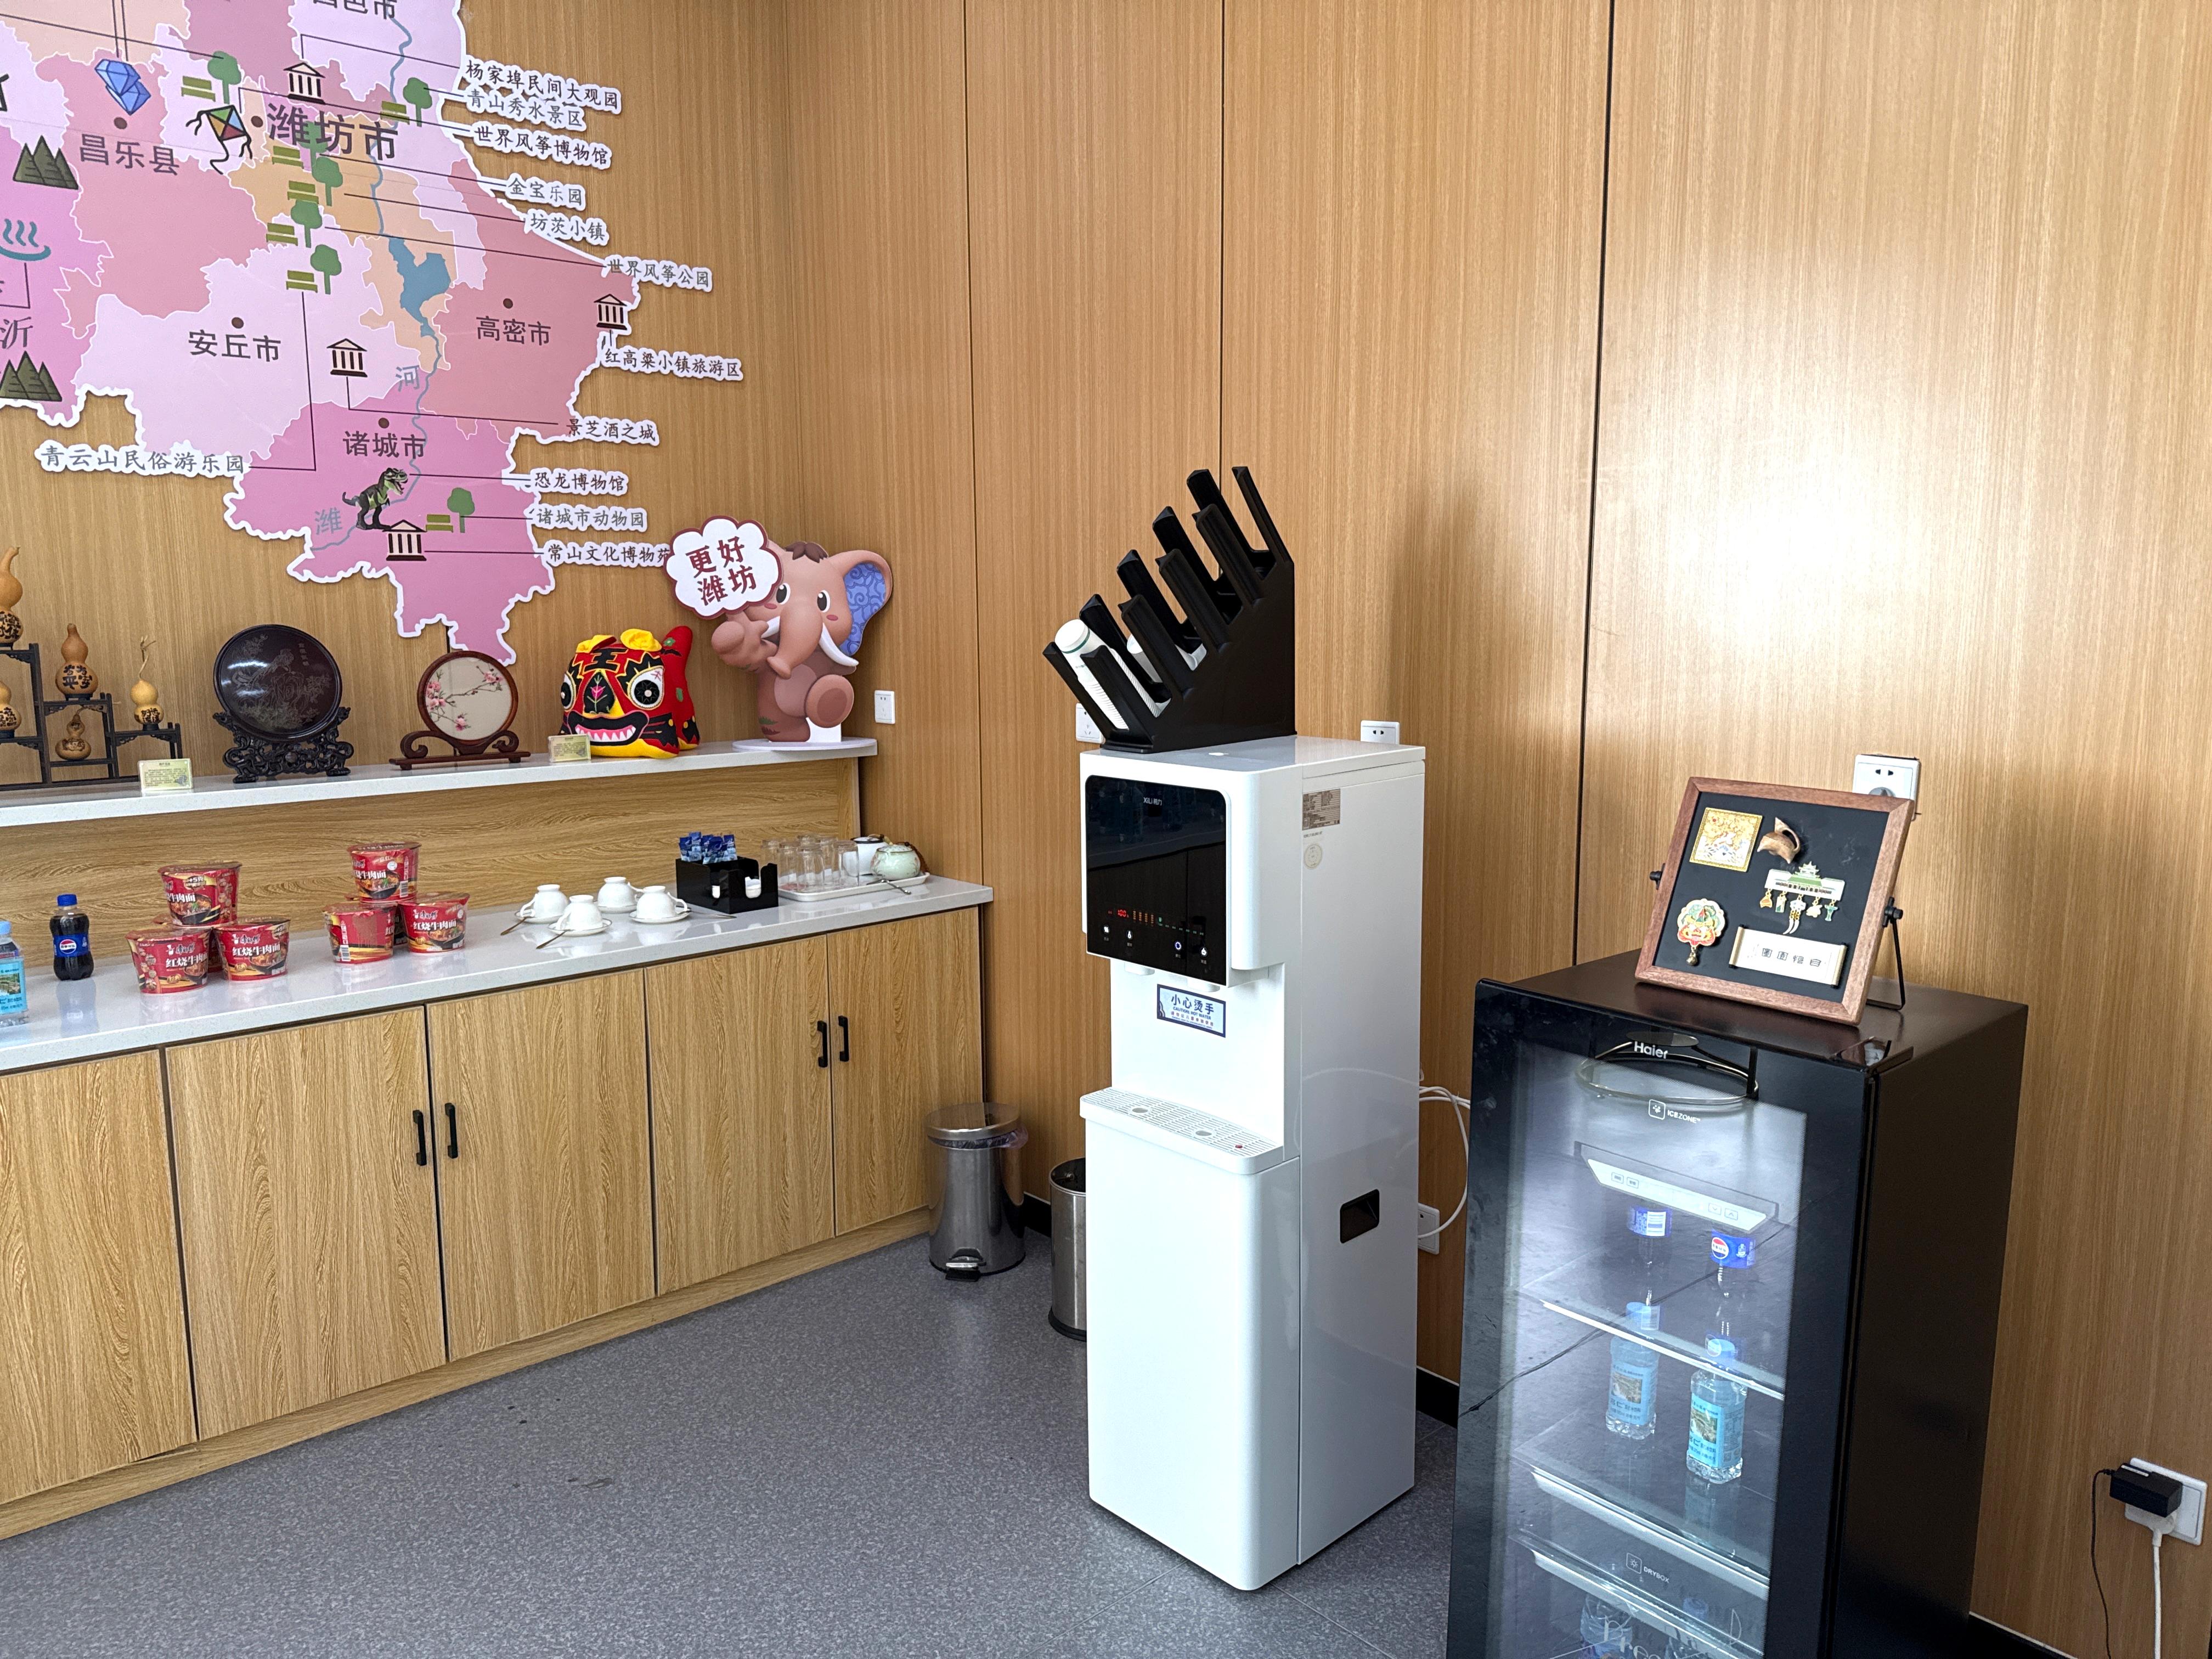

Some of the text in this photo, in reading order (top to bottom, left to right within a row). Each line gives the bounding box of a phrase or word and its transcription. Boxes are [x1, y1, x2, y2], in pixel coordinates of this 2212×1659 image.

[466, 59, 618, 109] 杨家埠民间大观园
[468, 89, 583, 127] 青山秀水景区
[267, 103, 398, 160] 潍坊市
[474, 125, 608, 165] 世界风筝博物馆
[80, 133, 179, 176] 昌乐县
[507, 177, 582, 205] 金宝乐园
[530, 212, 606, 240] 坊茨小镇
[607, 258, 709, 287] 世界风筝公园
[476, 315, 551, 346] 高密市
[188, 329, 281, 362] 安丘市
[605, 348, 741, 377] 红高粱小镇旅游区
[396, 365, 420, 392] 河
[567, 418, 656, 441] 景芝酒之城
[41, 445, 244, 473] 青云山民俗游乐园
[343, 431, 425, 459] 诸城市
[535, 472, 625, 492] 恐龙博物馆
[314, 506, 342, 535] 潍
[537, 508, 644, 528] 诸城市动物园
[548, 545, 669, 563] 常山文化博物苑
[686, 535, 745, 578] 更好
[697, 565, 757, 606] 潍坊
[413, 918, 456, 931] 红烧牛肉面
[1118, 909, 1127, 918] 100
[166, 952, 207, 968] 红烧牛肉面
[232, 941, 281, 956] 红烧牛肉面
[1171, 994, 1214, 1015] 小心烫手
[1634, 1041, 1668, 1059] Haier
[1644, 1566, 1670, 1584] DRYBOX
